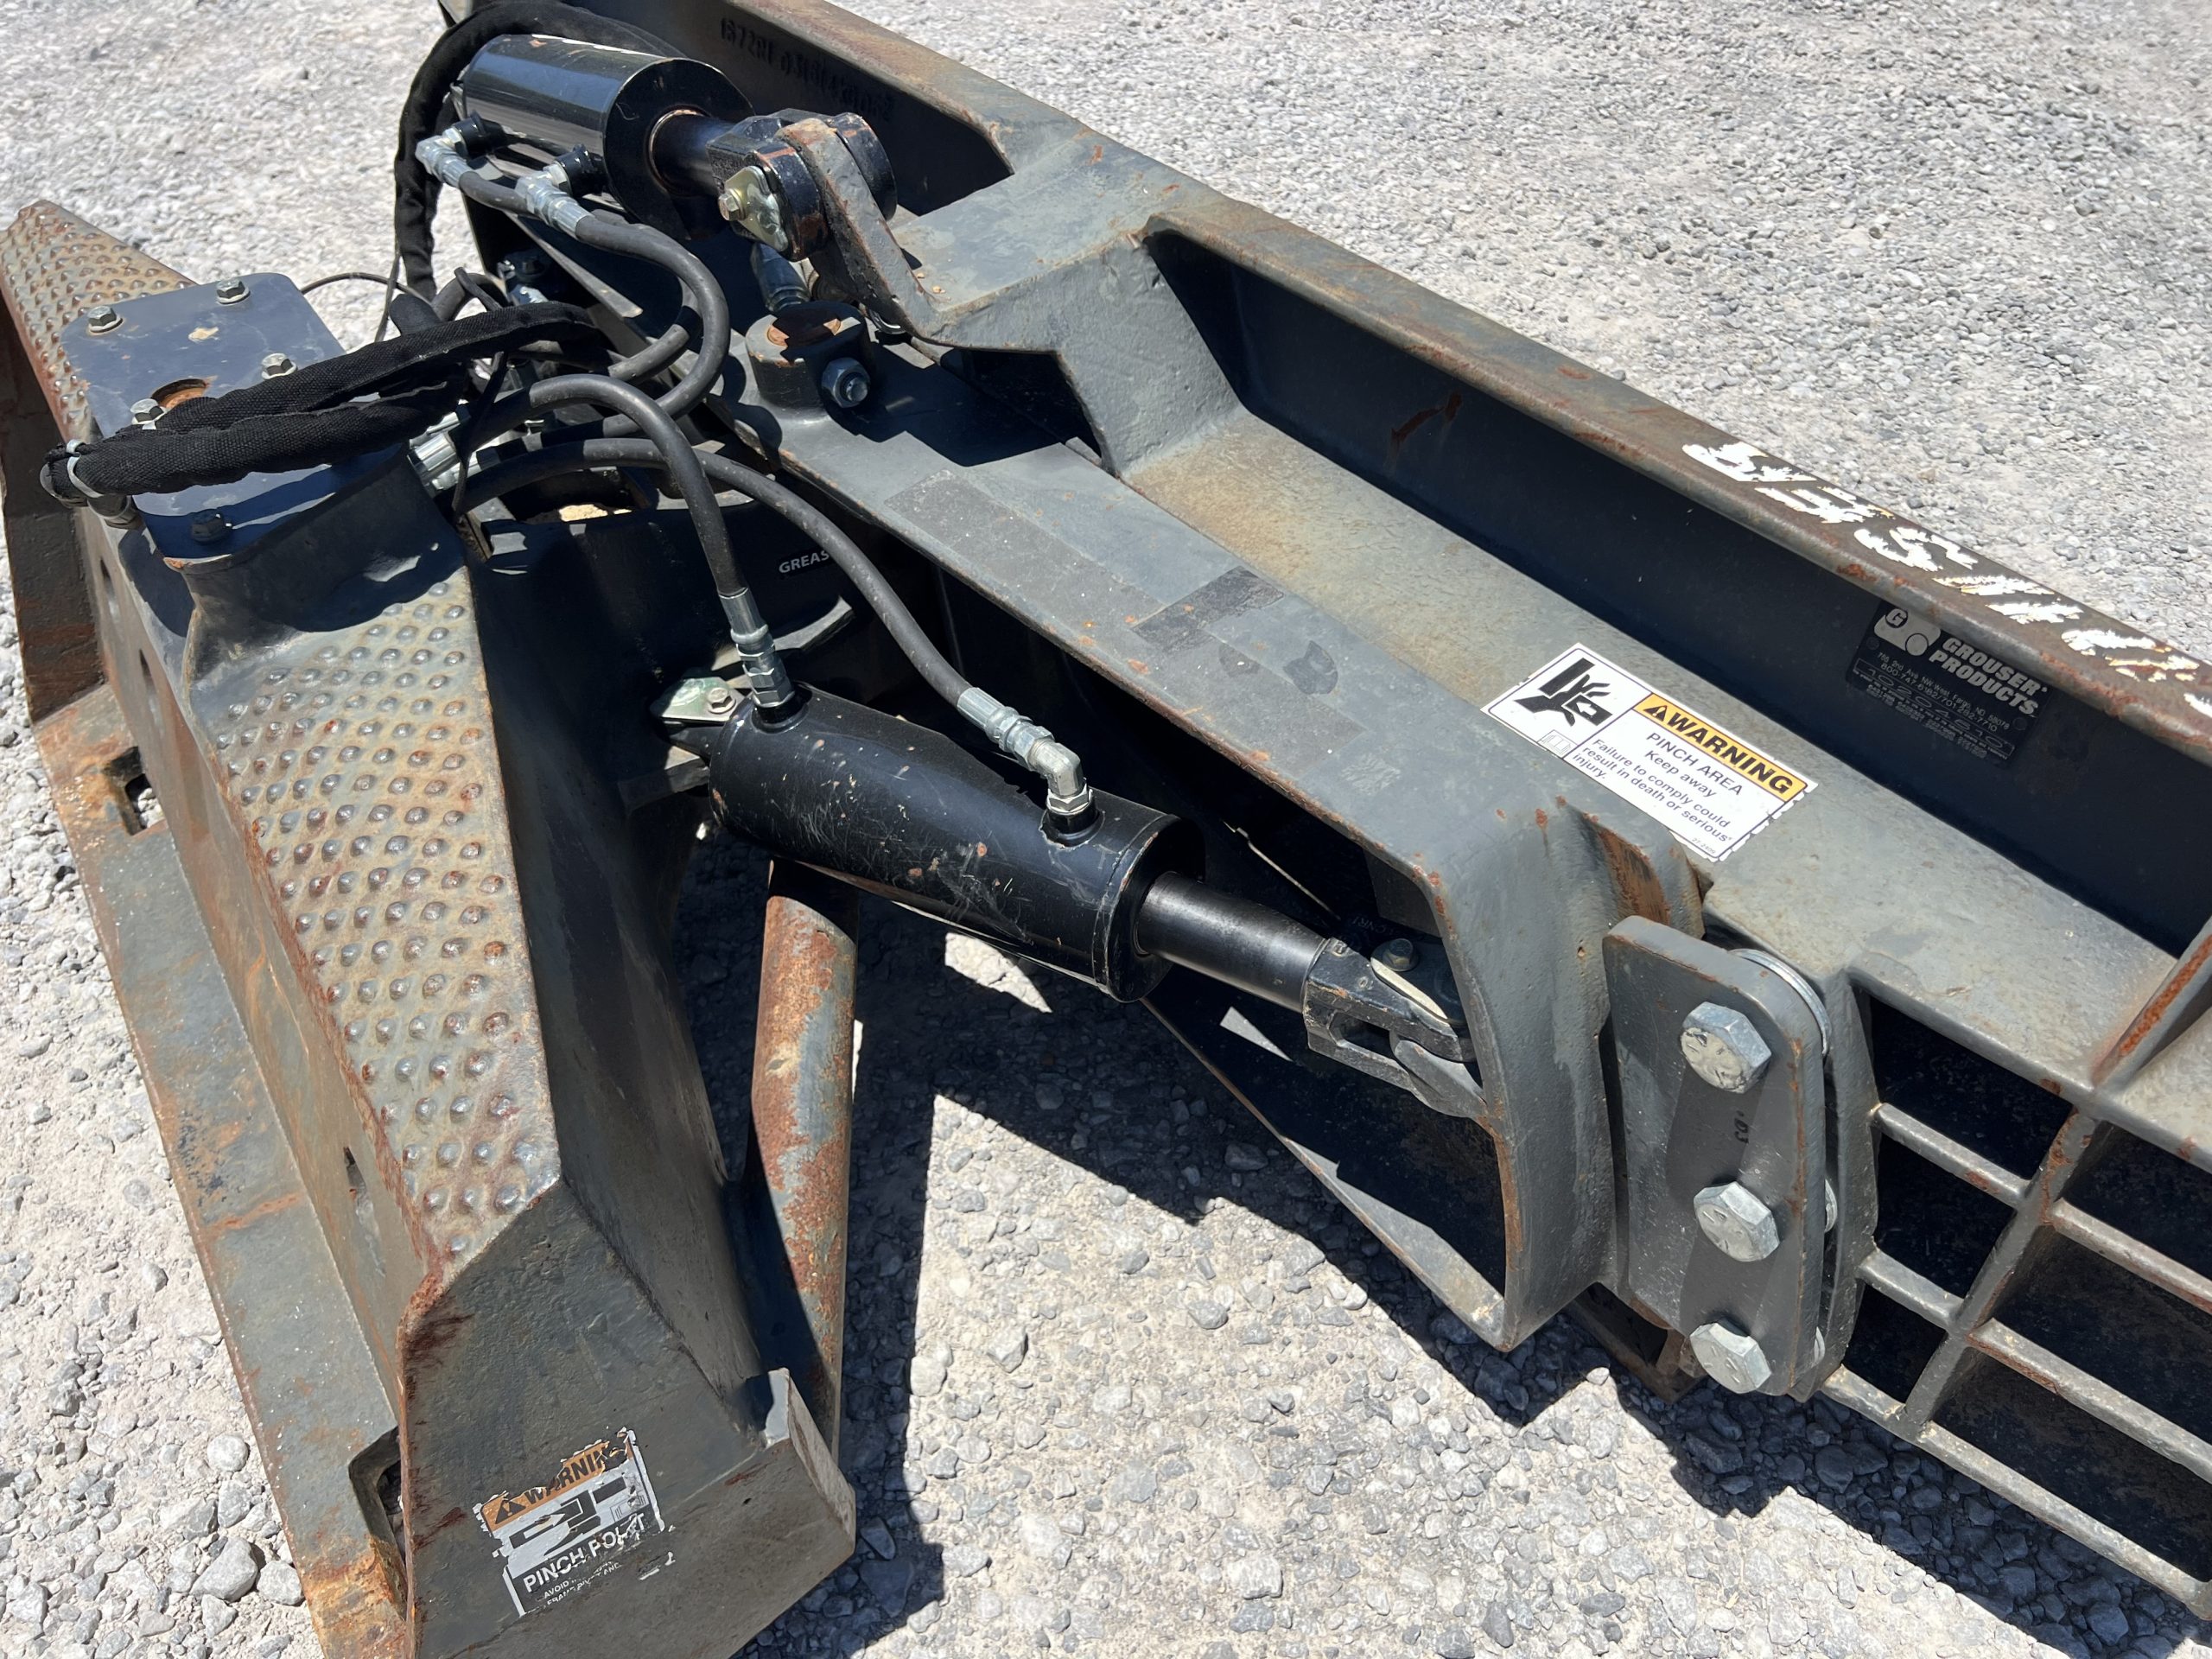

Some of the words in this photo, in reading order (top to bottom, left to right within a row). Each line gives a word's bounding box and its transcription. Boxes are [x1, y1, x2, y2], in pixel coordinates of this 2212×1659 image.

[779, 550, 830, 573] GREAS
[1928, 649, 2039, 716] PRODUCTS
[1569, 753, 1611, 780] injury.
[1642, 749, 1682, 776] Keep
[1677, 772, 1717, 798] away
[1645, 732, 1699, 766] PINCH
[1696, 763, 1746, 795] AREA
[1665, 712, 1795, 794] WARNING
[1581, 746, 1618, 770] result
[1615, 767, 1631, 779] in
[1629, 776, 1668, 801] death
[1664, 799, 1682, 811] or
[1680, 808, 1731, 842] serious
[1592, 739, 1635, 766] Failure
[1632, 764, 1649, 776] to
[1644, 772, 1694, 806] comply
[1691, 802, 1732, 828] could
[522, 1547, 584, 1593] PINCH
[543, 1580, 569, 1599] AVOID
